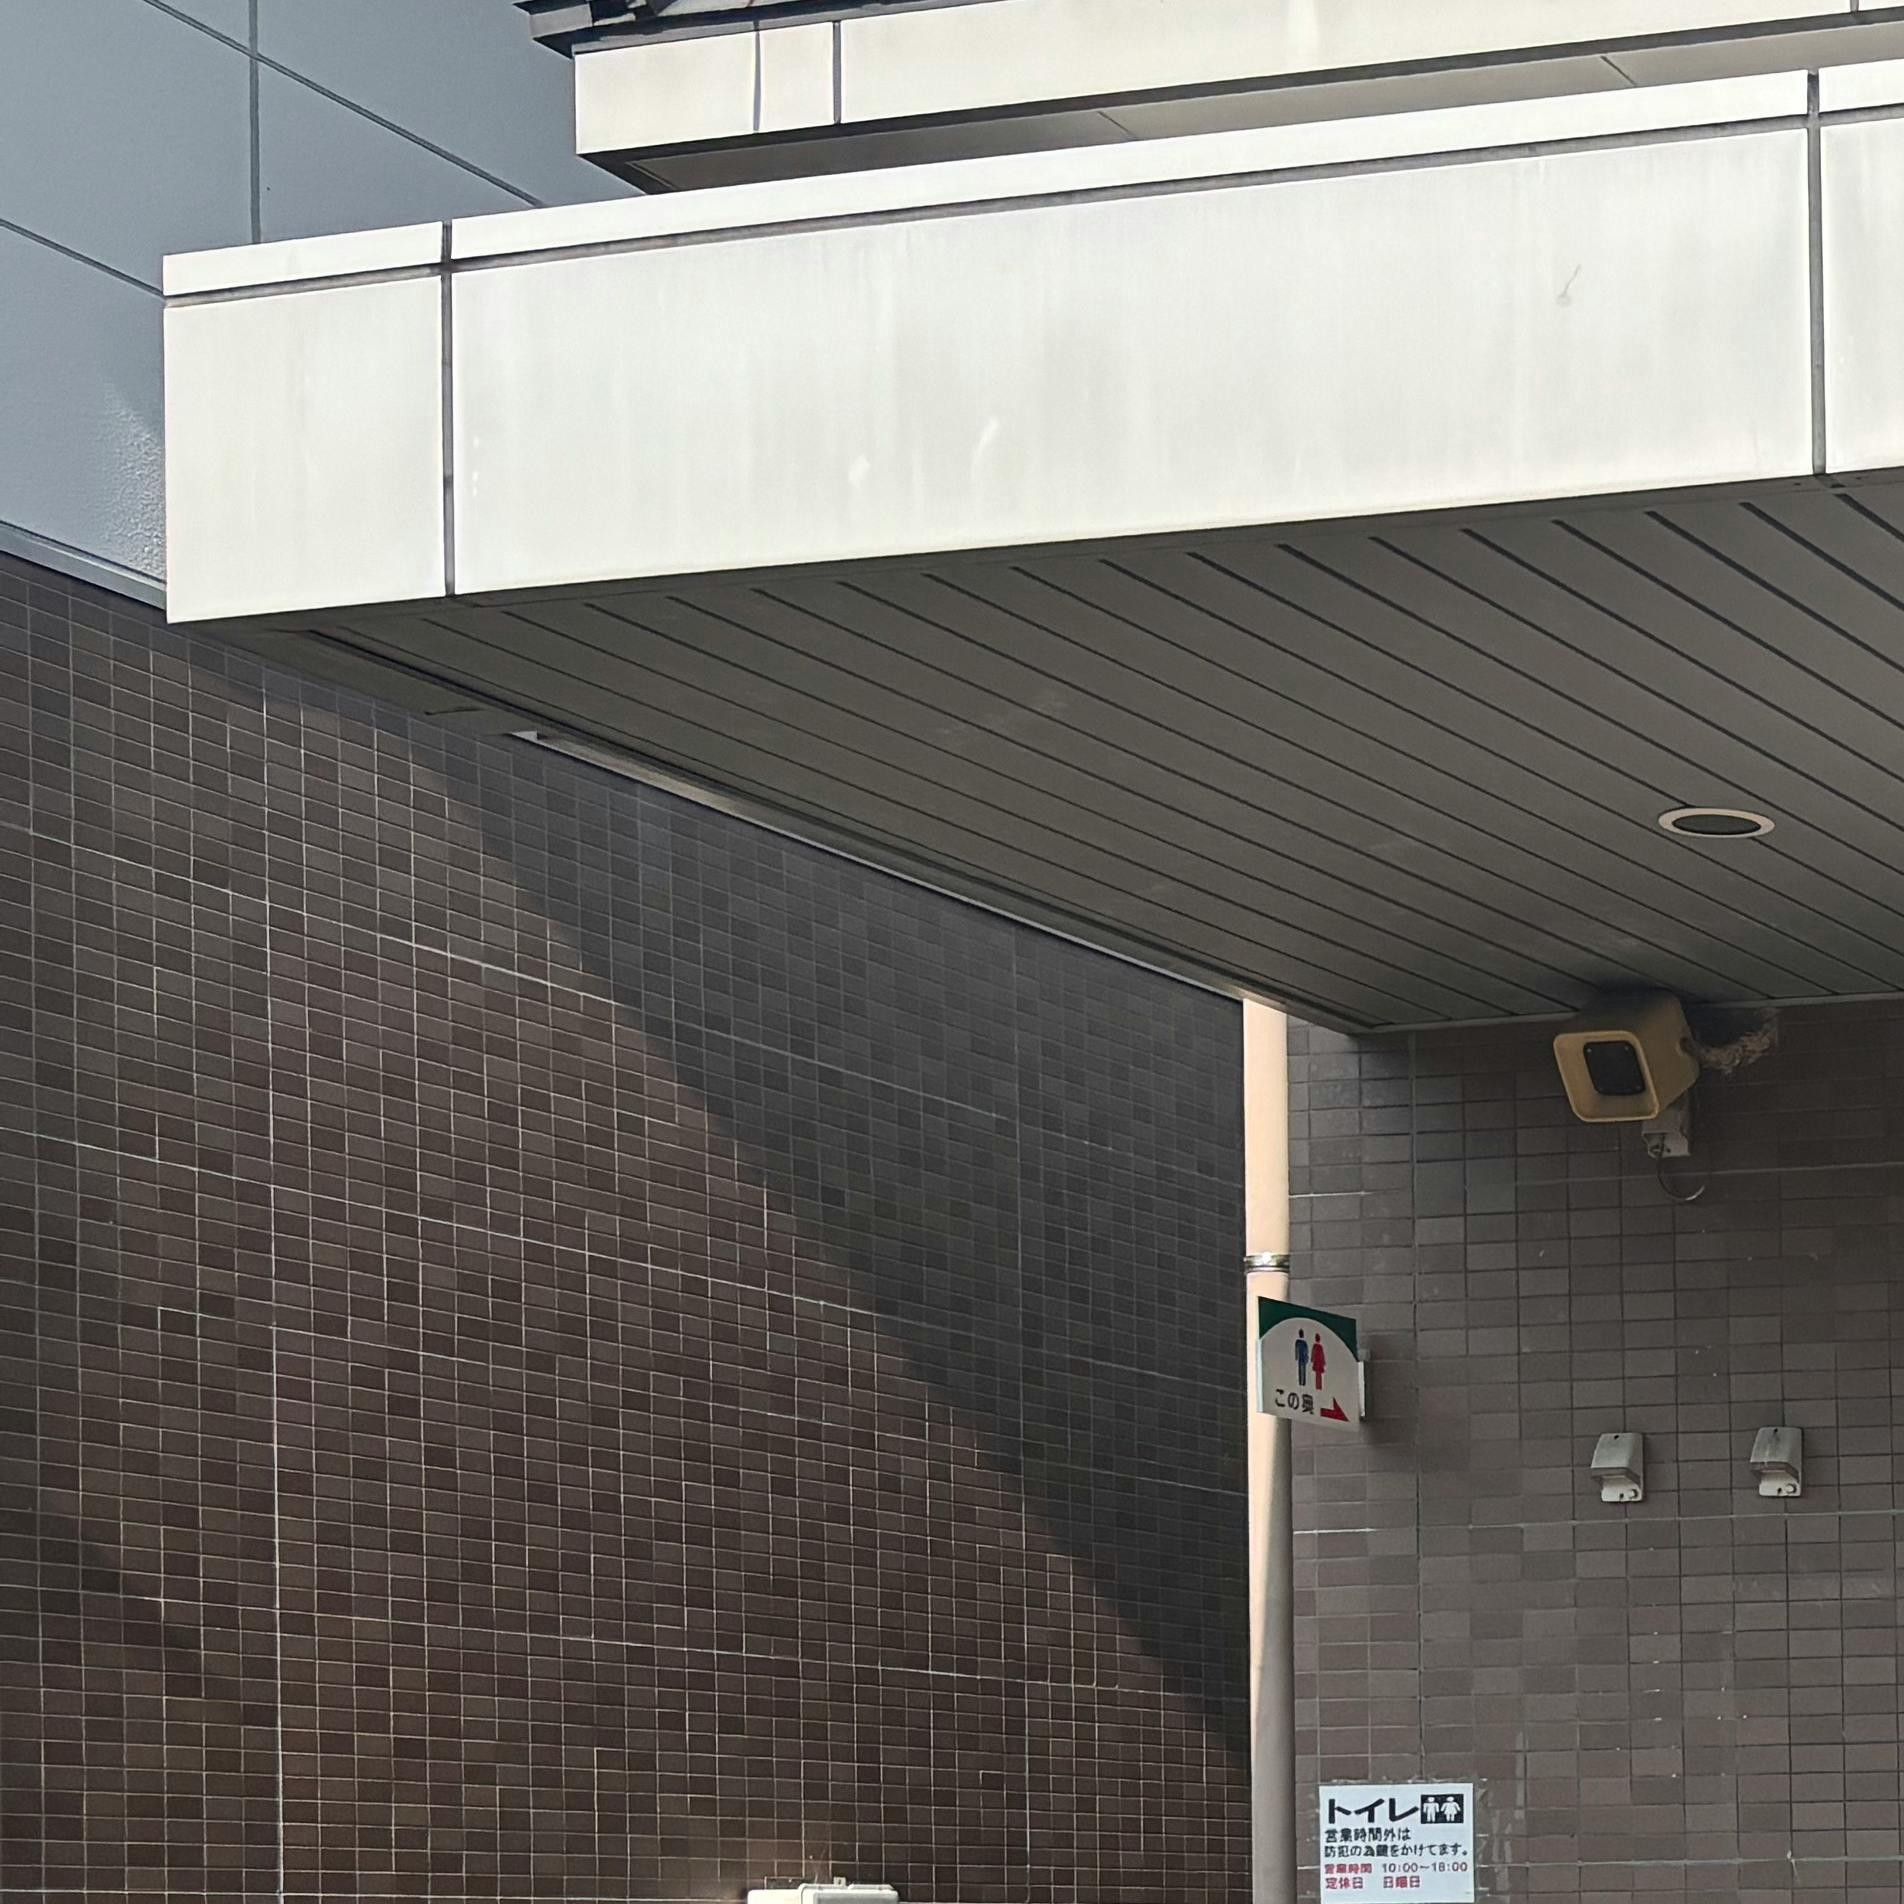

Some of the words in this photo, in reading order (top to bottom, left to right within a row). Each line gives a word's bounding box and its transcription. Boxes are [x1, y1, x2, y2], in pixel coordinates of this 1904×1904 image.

[1275, 1388, 1314, 1415] この奥
[1328, 1797, 1419, 1824] トイレ
[1324, 1827, 1411, 1843] 営業時間外は
[1324, 1843, 1468, 1858] 防犯の為鍵をかけてます。
[1324, 1863, 1372, 1875] 営業時間
[1325, 1877, 1364, 1890] 定休日
[1383, 1876, 1420, 1889] 日曜日
